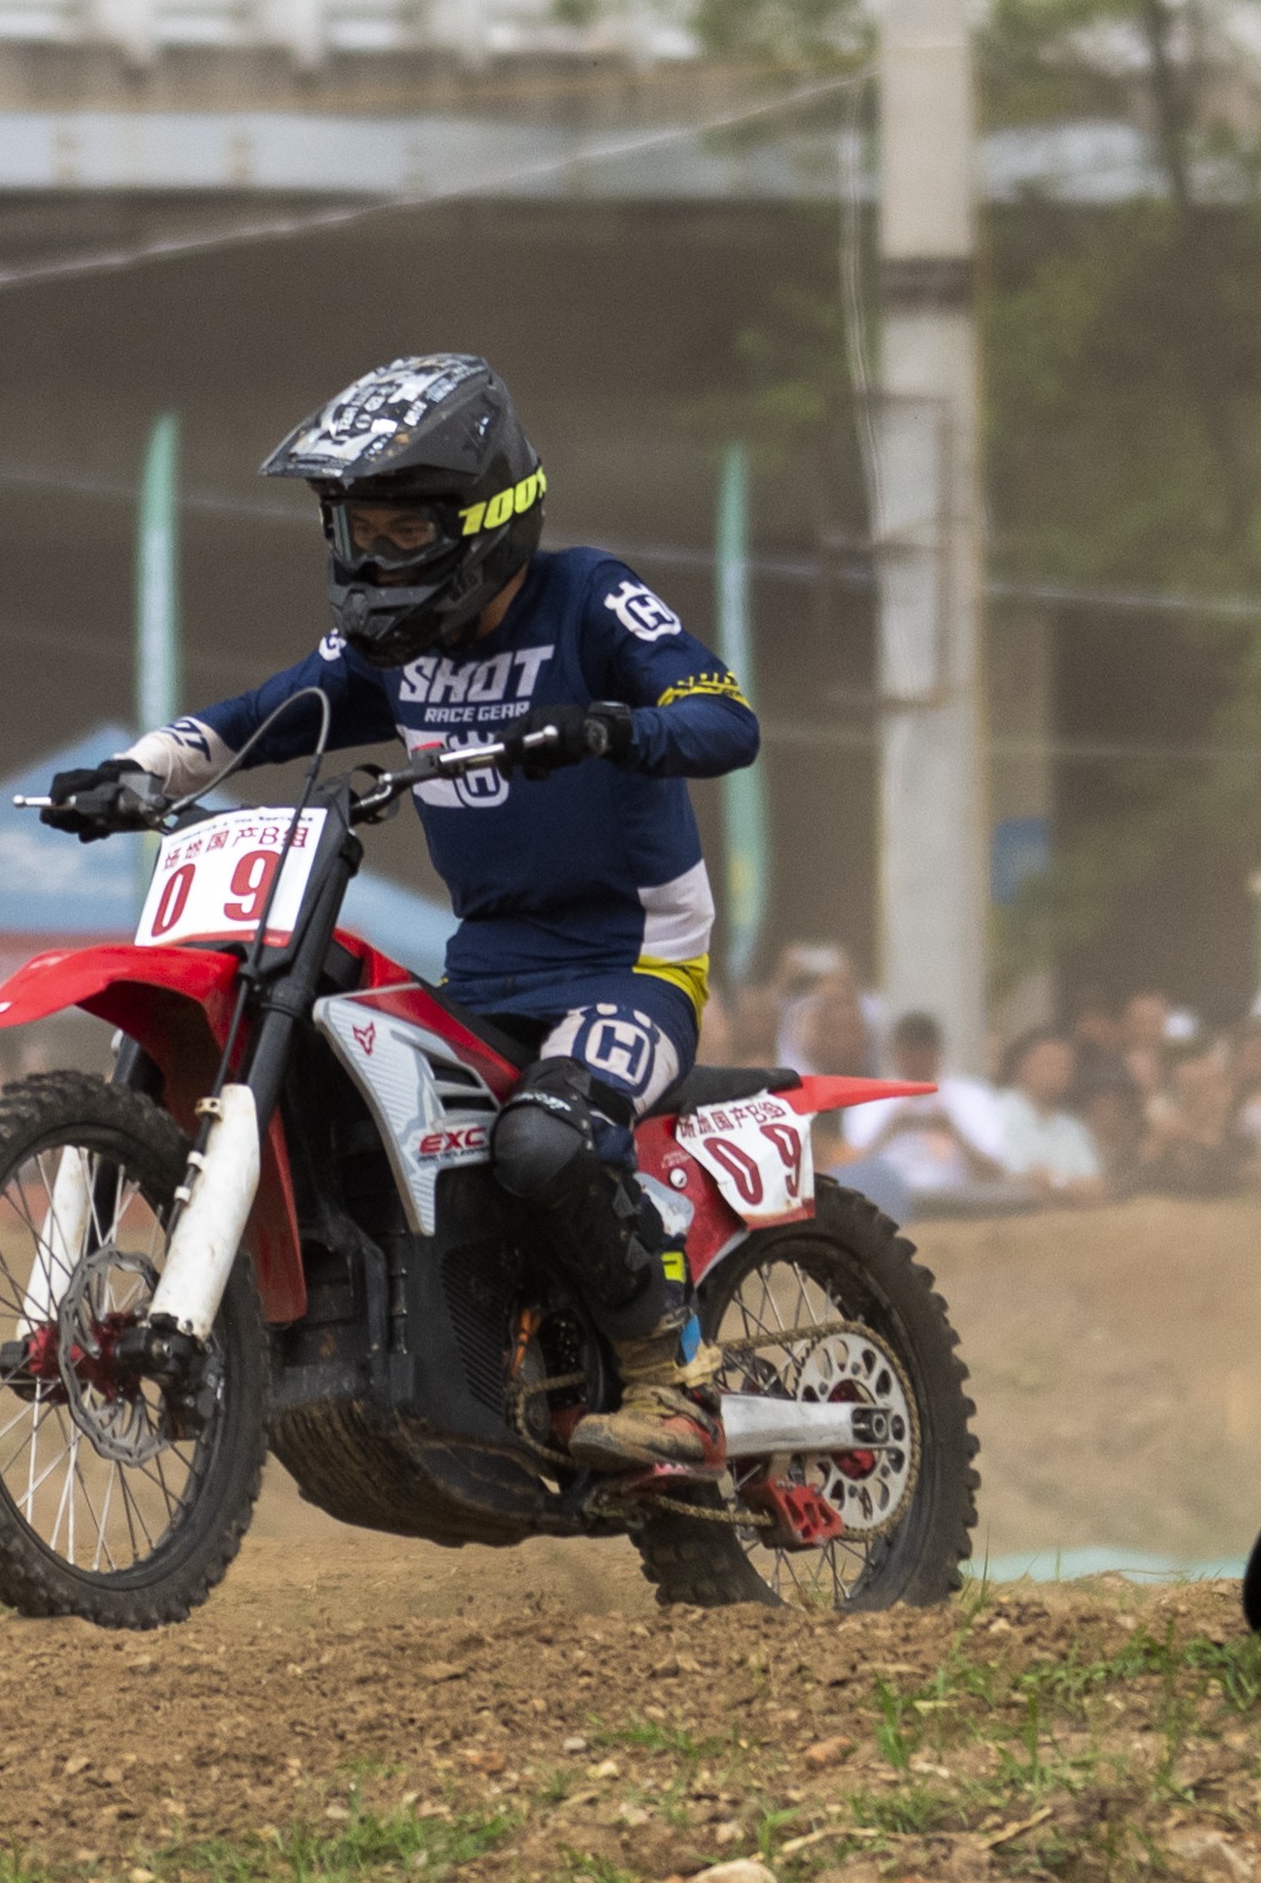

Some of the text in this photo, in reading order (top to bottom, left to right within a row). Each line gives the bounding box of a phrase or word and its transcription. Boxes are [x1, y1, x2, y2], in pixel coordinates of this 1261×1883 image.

[398, 643, 556, 703] SHOT
[424, 700, 531, 724] RACE GEAR
[150, 849, 282, 939] 09
[419, 1125, 487, 1155] EXC
[702, 1123, 803, 1207] 09
